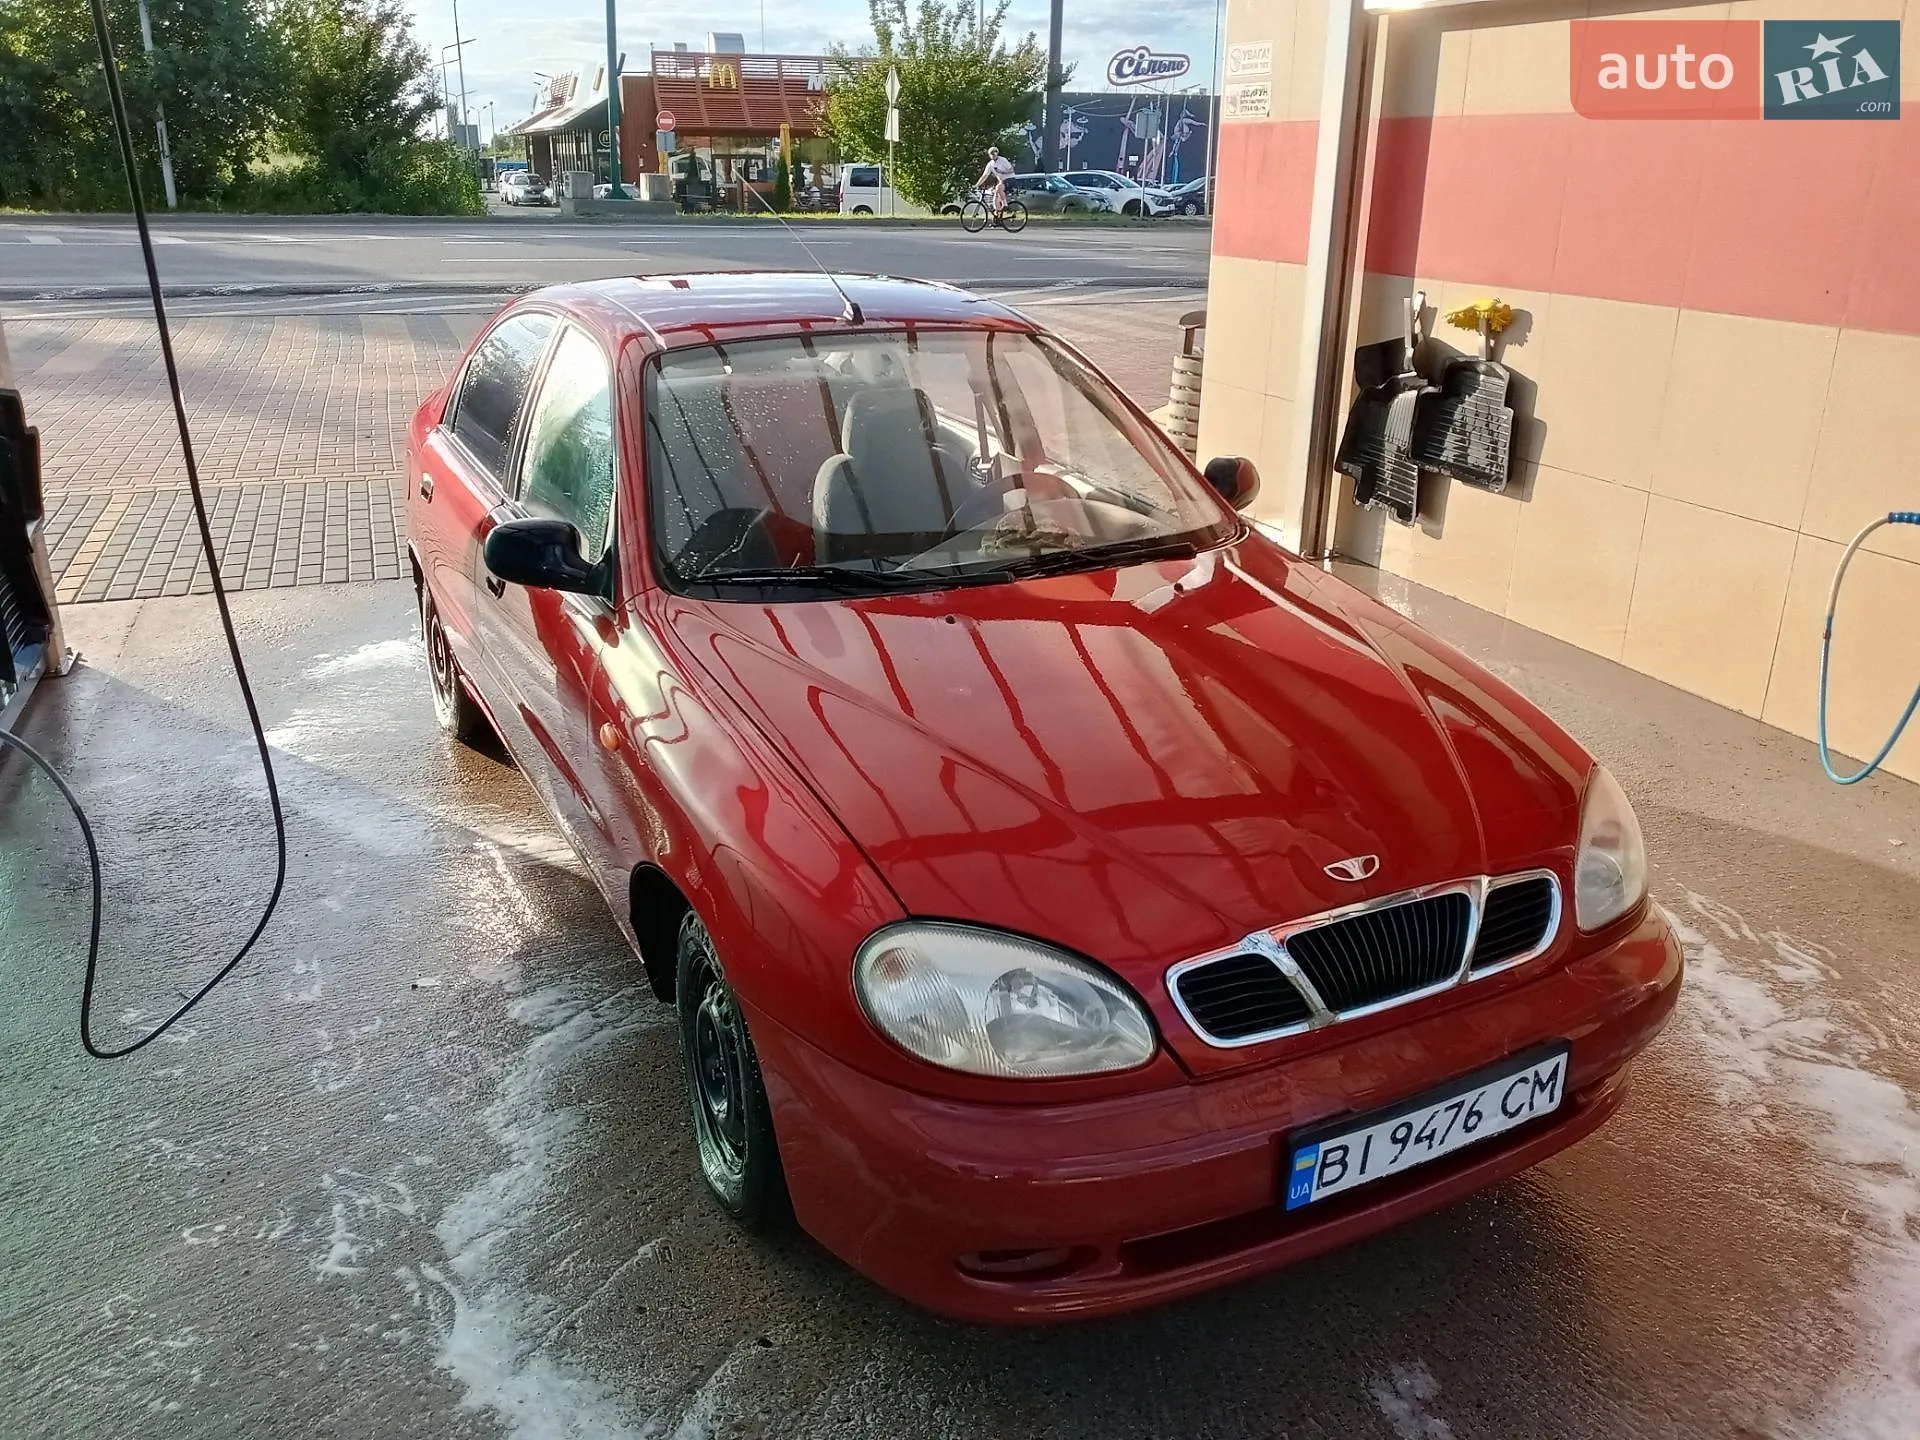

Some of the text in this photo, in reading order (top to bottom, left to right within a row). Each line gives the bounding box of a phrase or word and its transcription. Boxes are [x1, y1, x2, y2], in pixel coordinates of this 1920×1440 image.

[1316, 1061, 1561, 1191] BI 9476 CM
[1291, 1182, 1310, 1199] UA
